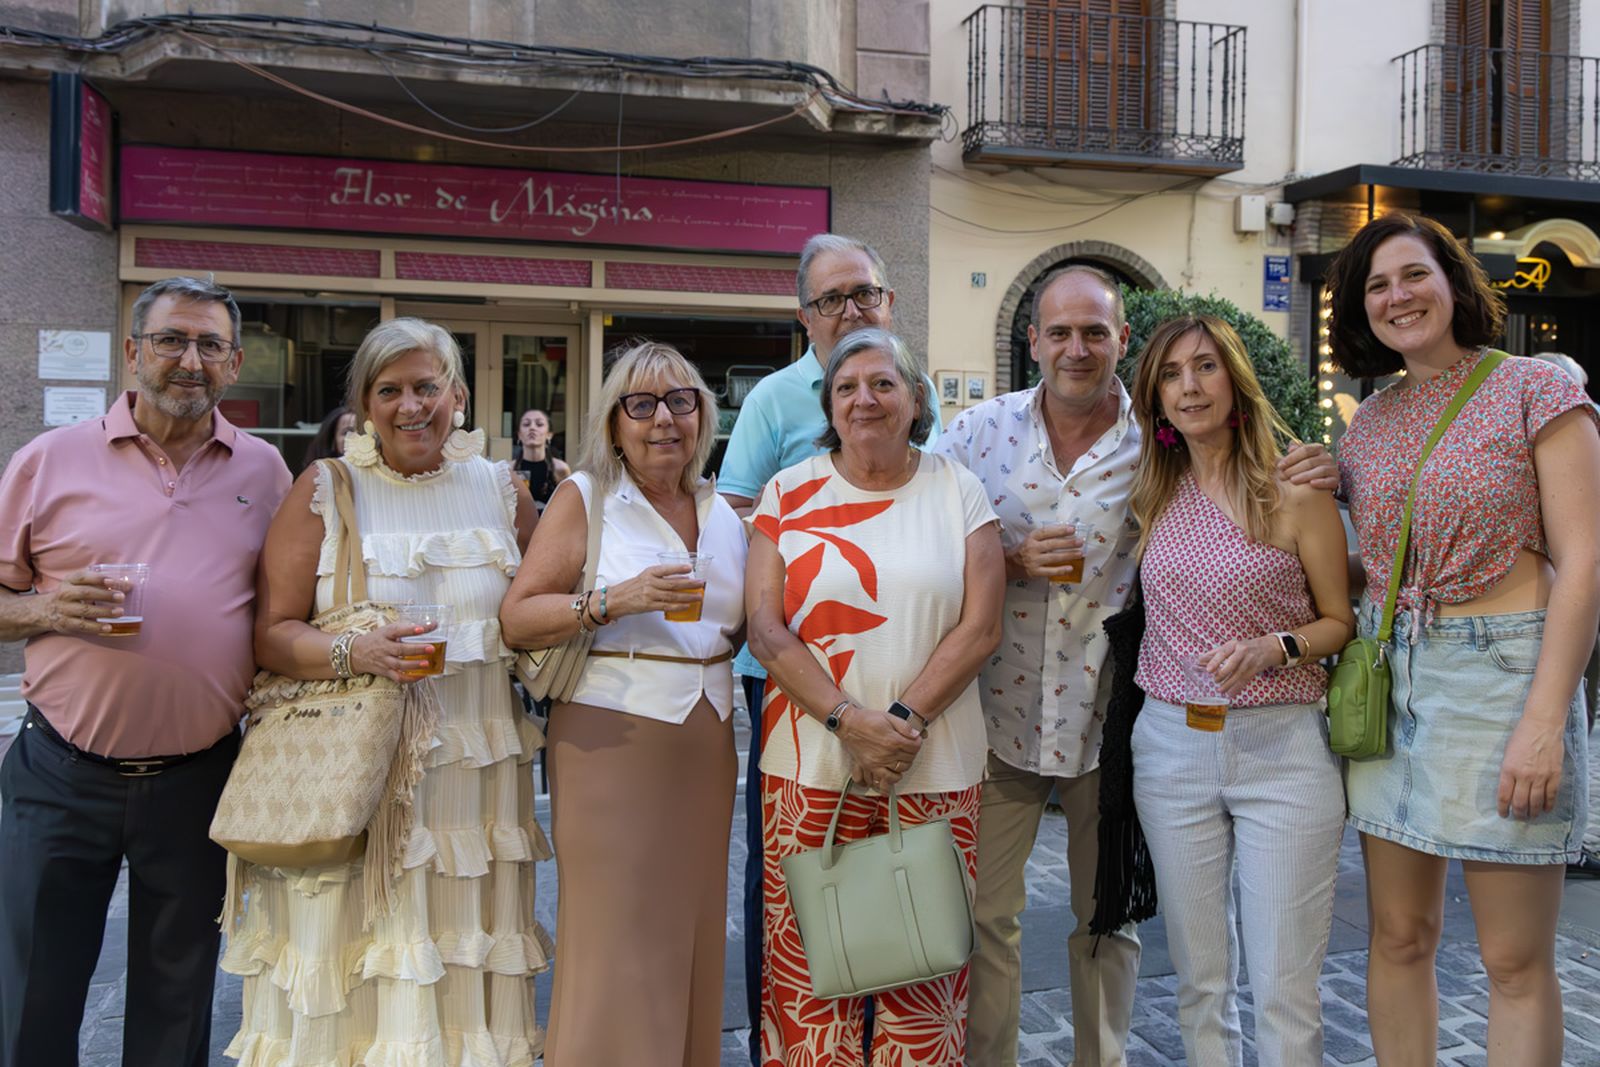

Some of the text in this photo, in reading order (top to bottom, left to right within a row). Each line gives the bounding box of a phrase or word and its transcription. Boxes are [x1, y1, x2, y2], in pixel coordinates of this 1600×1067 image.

[330, 167, 412, 206] Flor
[436, 187, 467, 210] de
[490, 177, 653, 236] Mágina
